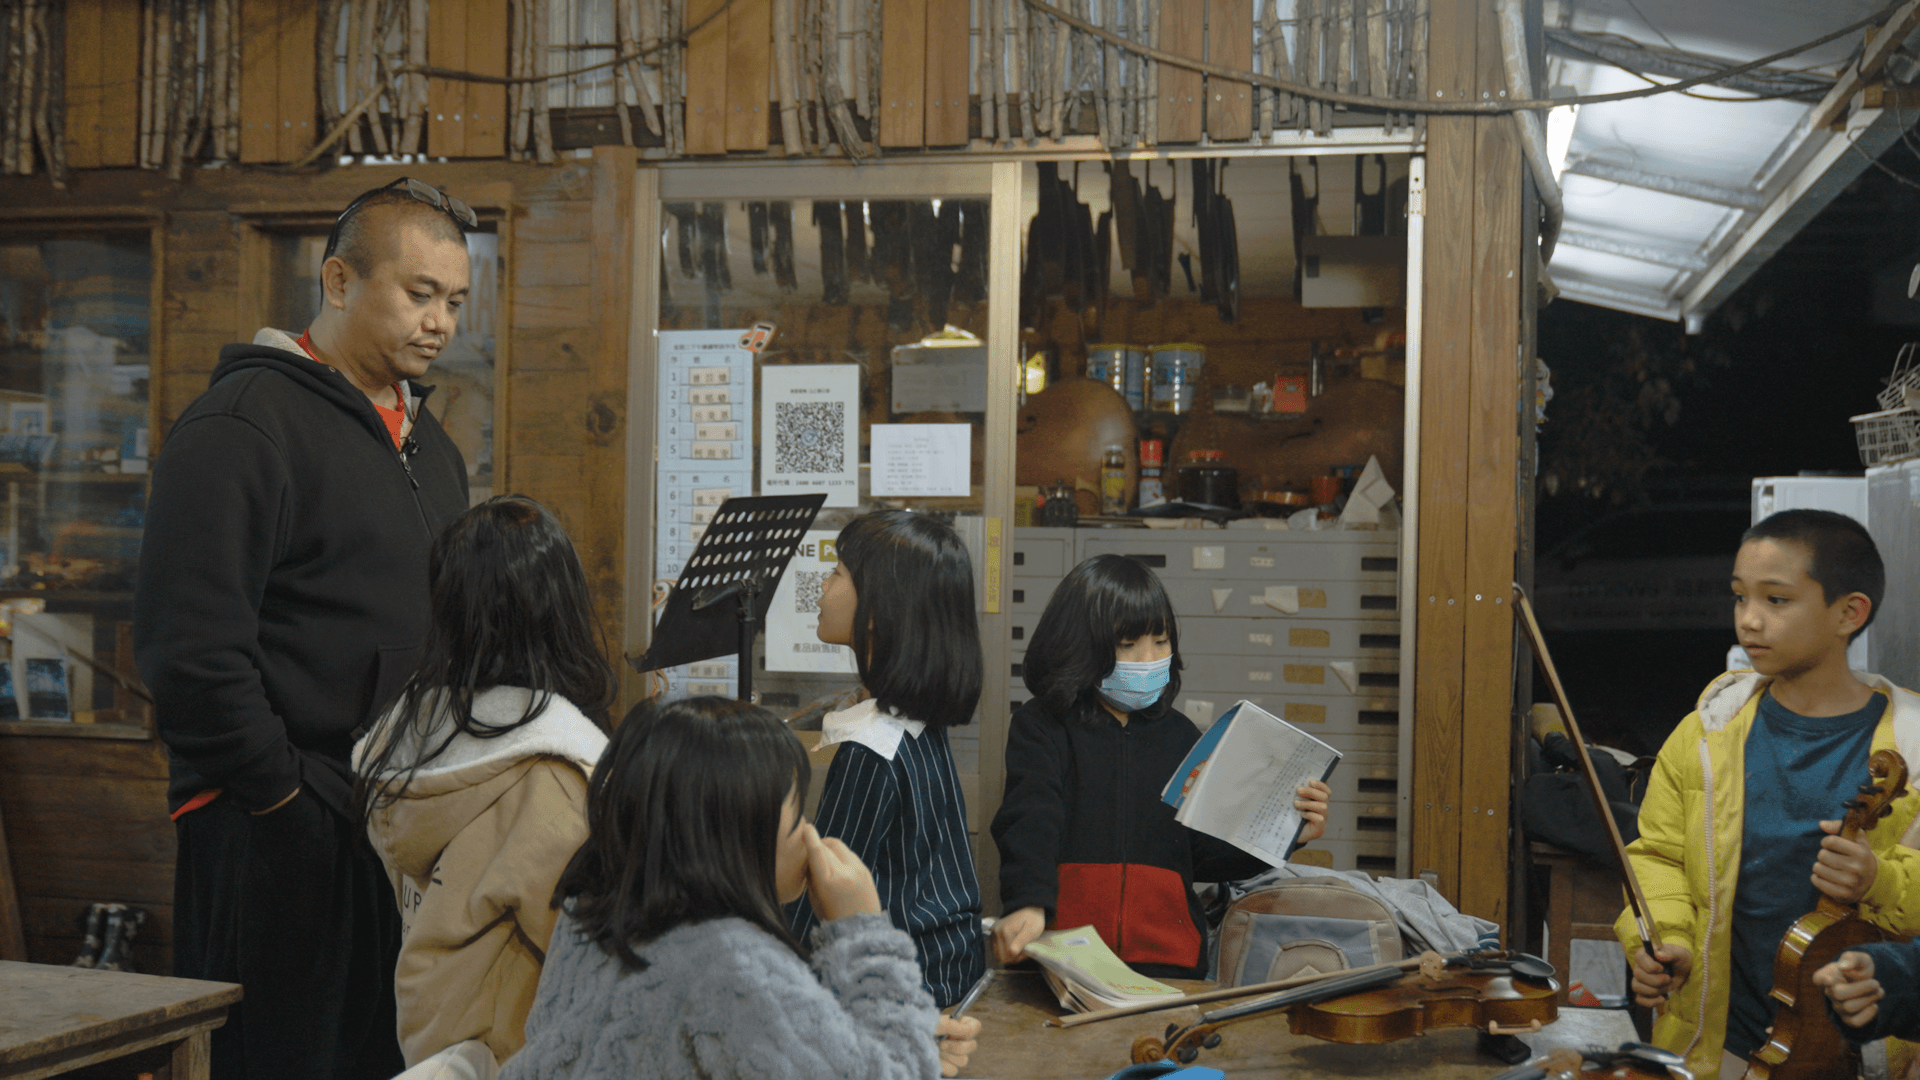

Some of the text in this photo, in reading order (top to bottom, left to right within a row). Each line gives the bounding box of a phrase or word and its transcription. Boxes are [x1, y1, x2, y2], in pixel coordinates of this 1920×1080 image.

[671, 372, 676, 381] 1
[670, 390, 677, 399] 2
[670, 408, 676, 417] 3
[669, 426, 677, 435] 4
[670, 445, 677, 454] 5
[669, 491, 676, 500] 6
[669, 509, 676, 518] 7
[669, 527, 676, 536] 8
[669, 545, 676, 555] 9
[667, 564, 679, 574] 10
